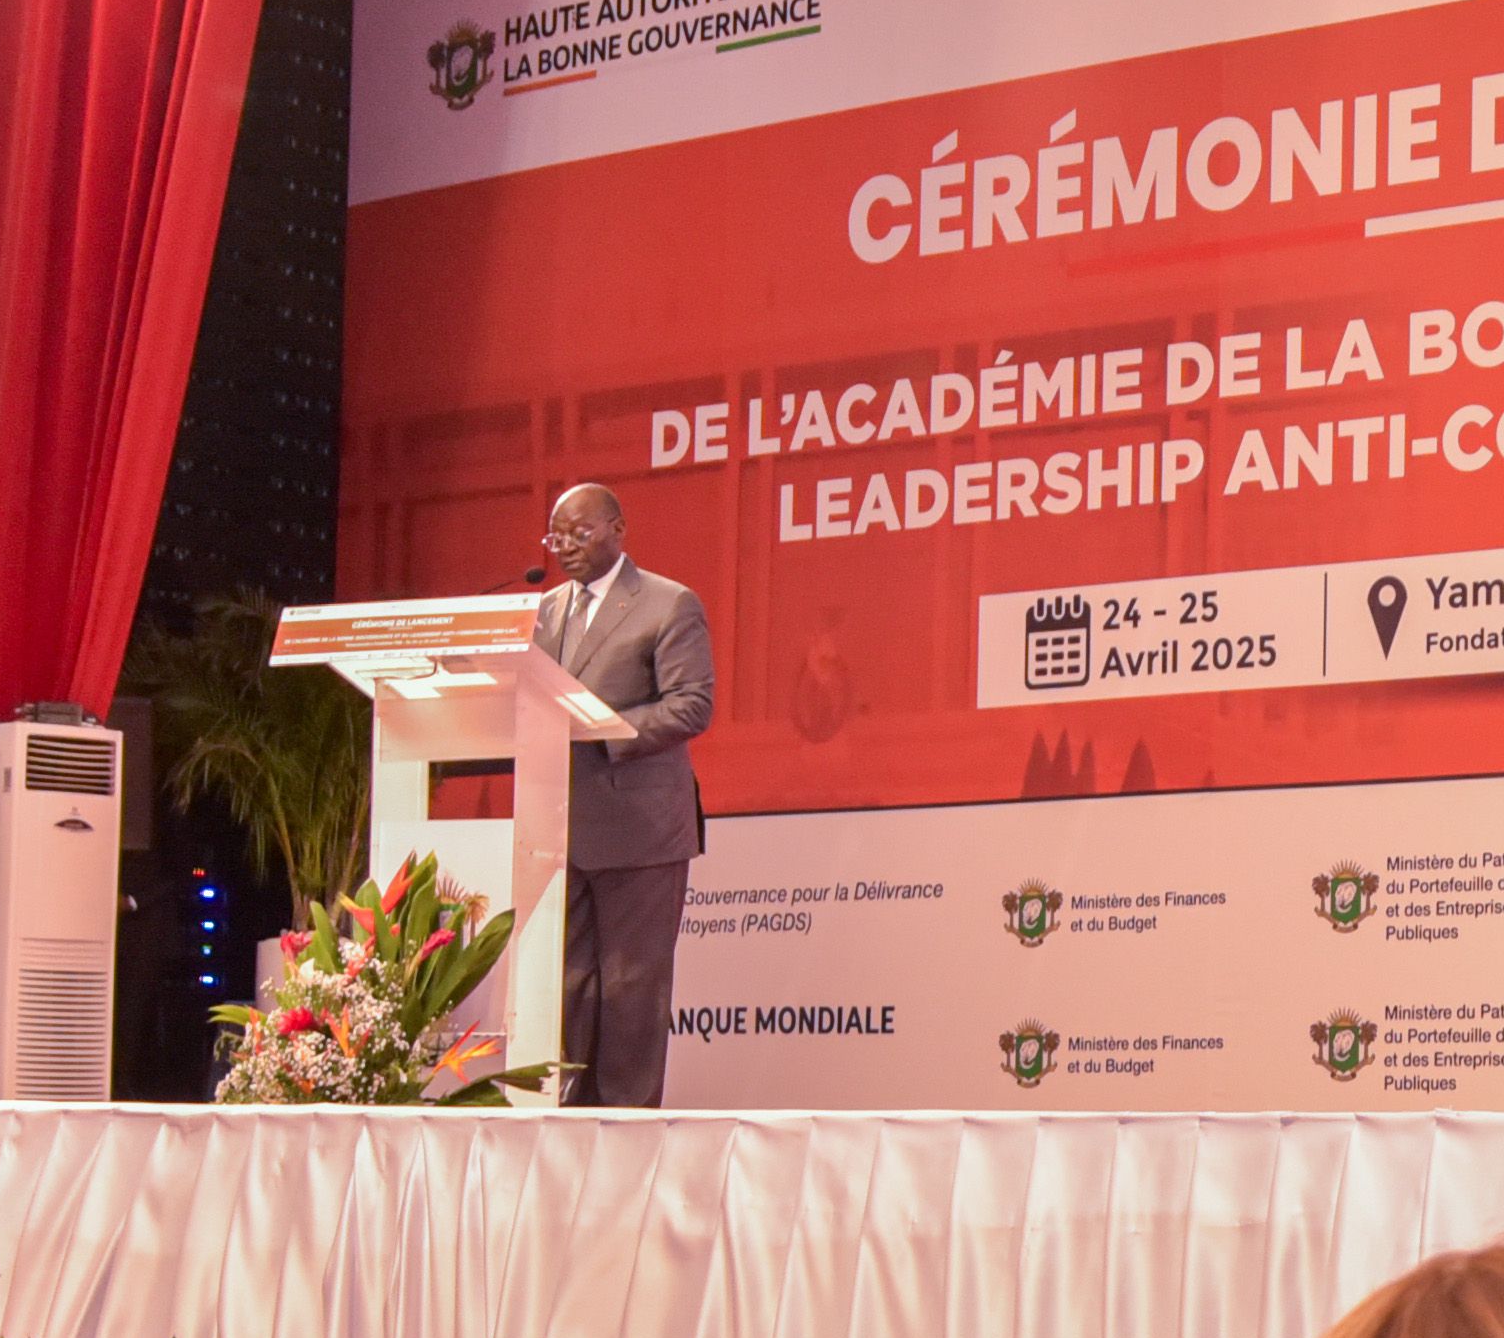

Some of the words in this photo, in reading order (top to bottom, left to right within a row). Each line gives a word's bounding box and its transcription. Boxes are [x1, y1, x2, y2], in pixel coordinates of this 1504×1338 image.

[505, 2, 590, 47] HAUTE
[504, 54, 532, 83] LA
[539, 34, 621, 75] BONNE
[849, 84, 1441, 263] CÉRÉMONIE
[652, 403, 729, 468] DE
[1167, 332, 1261, 405] DE
[1286, 319, 1384, 390] LA
[780, 439, 1204, 542] LEADERSHIP
[1103, 598, 1141, 631] 24
[1180, 591, 1218, 624] 25
[1100, 640, 1178, 678] Avril
[1191, 635, 1276, 671] 2025
[1387, 855, 1454, 871] Ministère
[1459, 854, 1477, 868] du
[684, 887, 787, 906] Gouvernance
[791, 888, 830, 906] pour
[835, 883, 848, 901] la
[854, 881, 943, 900] Délivrance
[1386, 880, 1404, 894] du
[1410, 877, 1493, 893] Portefeuille
[1071, 894, 1132, 909] Ministère
[1136, 893, 1160, 907] des
[1165, 892, 1226, 906] Finances
[1386, 904, 1399, 917] et
[1404, 902, 1431, 917] des
[680, 917, 736, 938] itoyens
[741, 912, 811, 936] (PAGDS)
[1071, 919, 1083, 932] et
[1087, 917, 1104, 931] du
[1109, 916, 1156, 933] Budget
[1386, 925, 1458, 942] Publiques
[755, 1006, 895, 1034] MONDIALE
